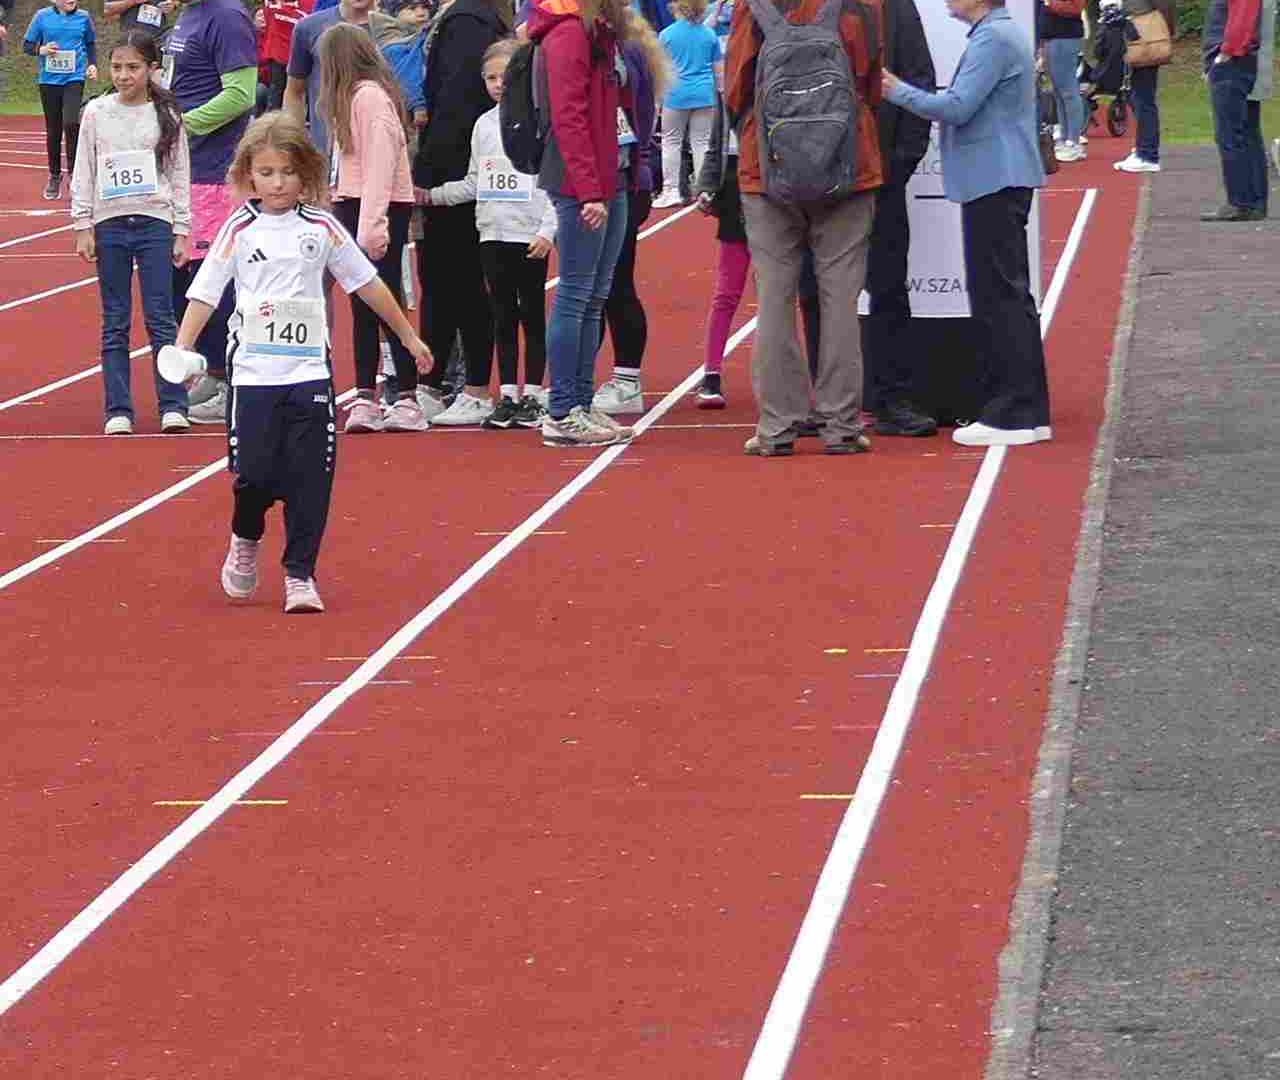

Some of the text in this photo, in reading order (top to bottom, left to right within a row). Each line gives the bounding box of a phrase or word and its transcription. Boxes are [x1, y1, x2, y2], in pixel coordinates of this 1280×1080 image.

[111, 169, 143, 187] 185
[488, 173, 518, 190] 186
[265, 322, 307, 345] 140
